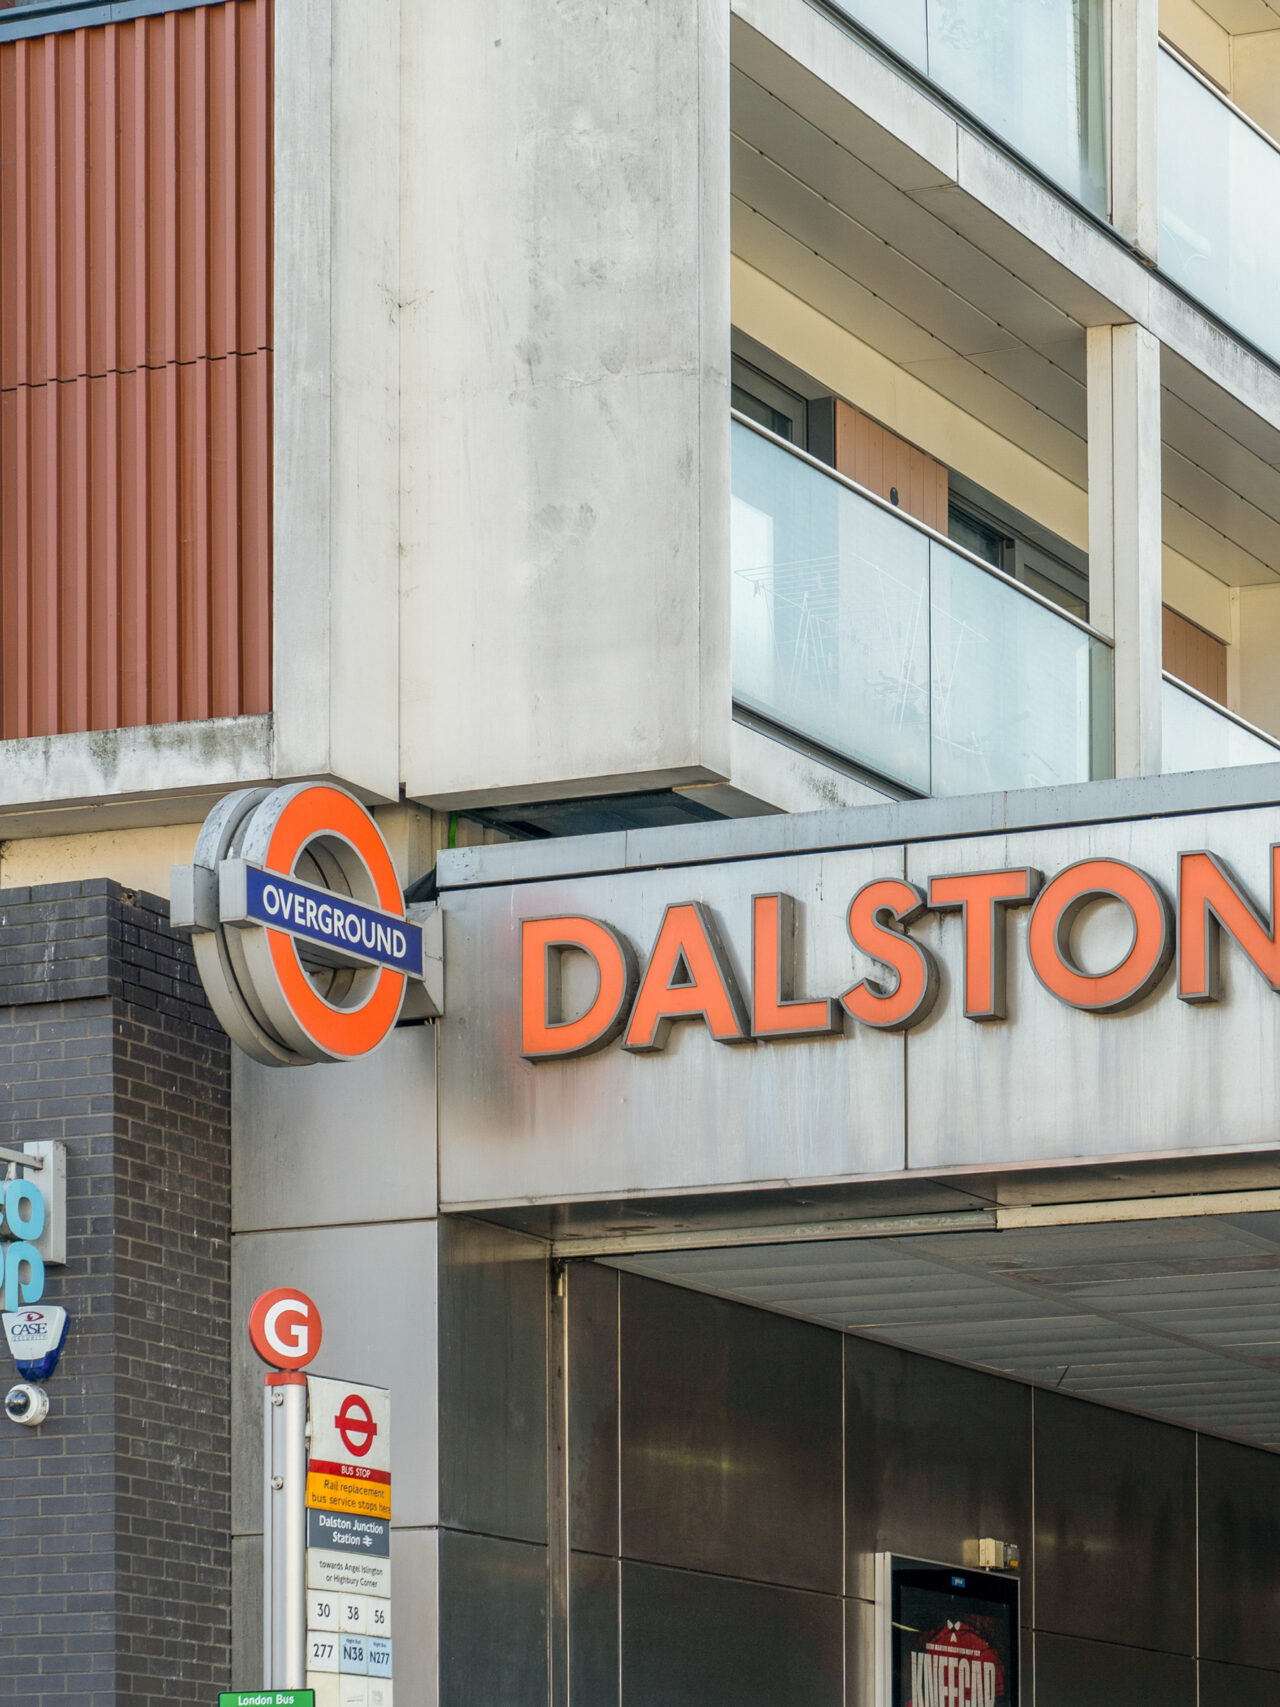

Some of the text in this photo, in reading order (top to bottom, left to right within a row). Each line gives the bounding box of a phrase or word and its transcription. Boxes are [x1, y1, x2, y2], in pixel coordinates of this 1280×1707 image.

[263, 884, 407, 958] OVERGROUND
[0, 1178, 45, 1241] o
[0, 1241, 45, 1313] p
[11, 1323, 48, 1336] CASE
[264, 1299, 309, 1358] G
[341, 1465, 371, 1478] BUS STOP
[324, 1480, 385, 1499] Rail replacement
[312, 1492, 327, 1503] bus
[329, 1496, 356, 1508] service
[358, 1500, 377, 1512] stops
[319, 1515, 383, 1535] Dalston Junction
[332, 1531, 361, 1545] Station
[319, 1560, 384, 1576] towards Angel Islington
[333, 1574, 359, 1587] Highbury
[359, 1577, 378, 1588] Corner
[317, 1603, 331, 1618] 30
[347, 1606, 360, 1621] 38
[374, 1610, 385, 1624] 56
[313, 1644, 334, 1658] 277
[343, 1646, 364, 1662] N38
[369, 1651, 390, 1665] N277
[238, 1694, 294, 1706] London Bus
